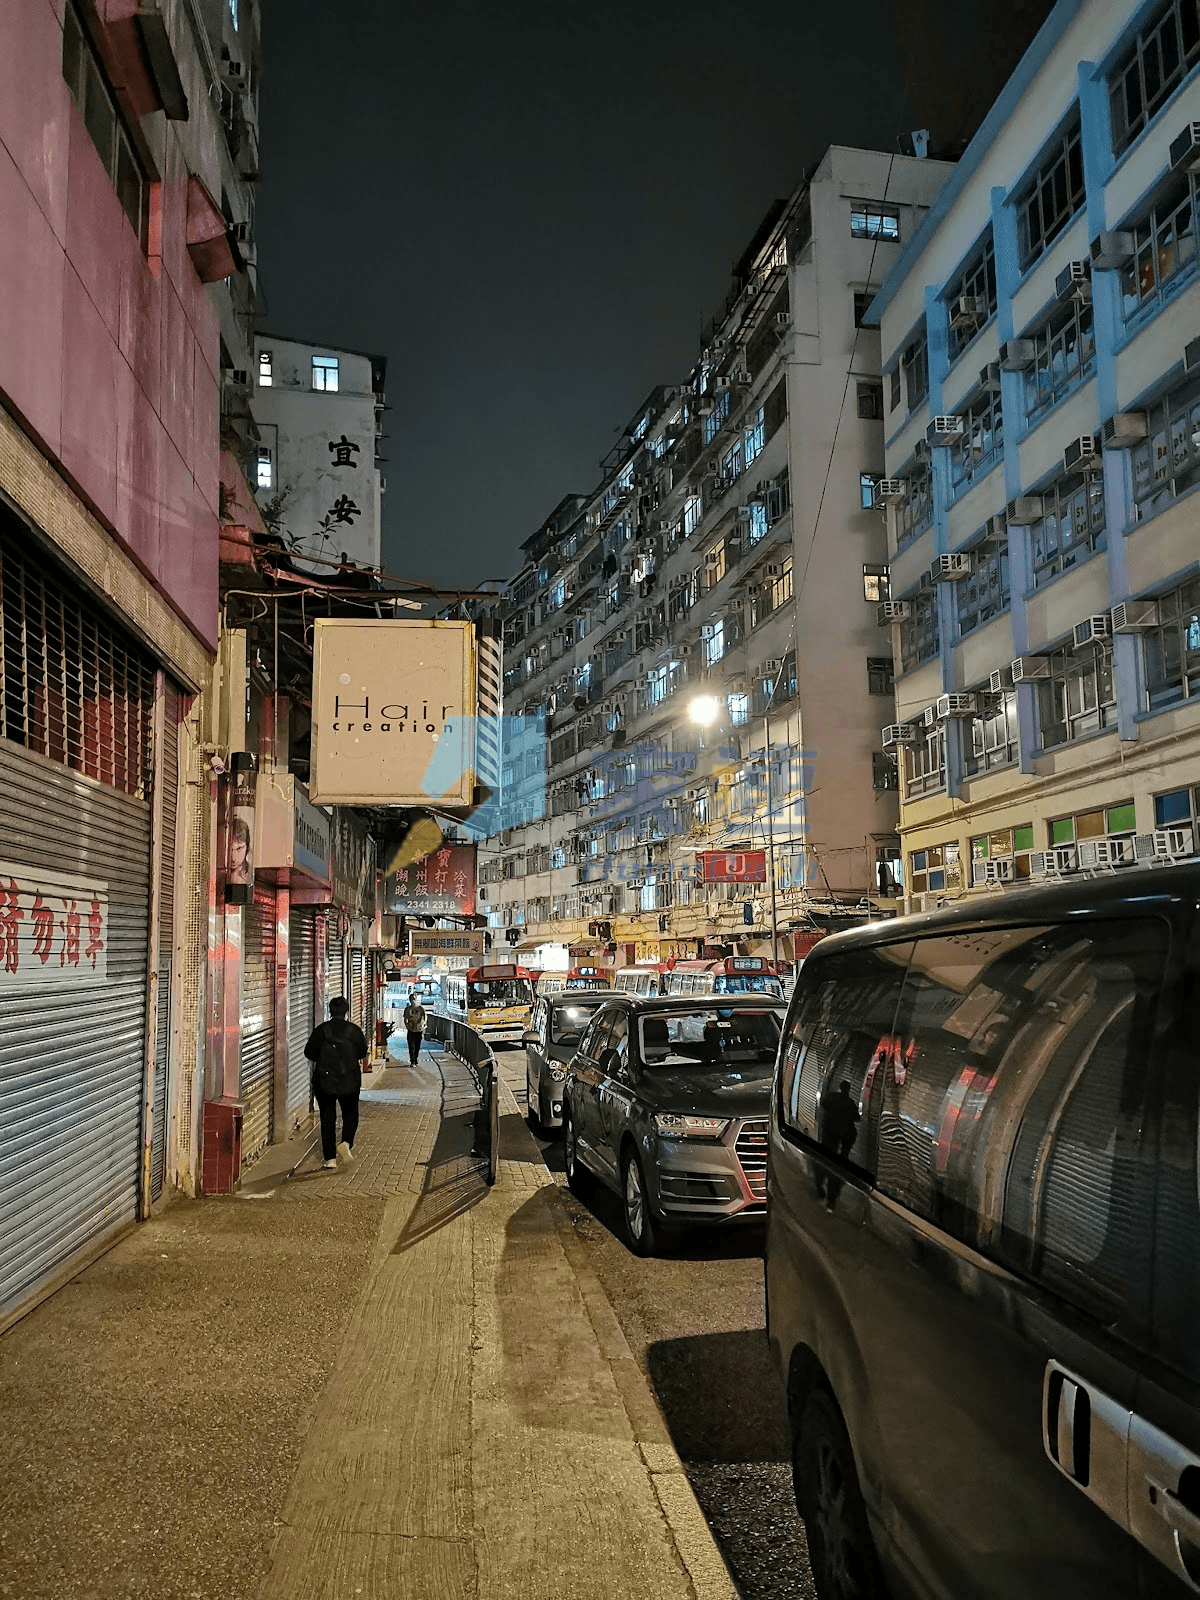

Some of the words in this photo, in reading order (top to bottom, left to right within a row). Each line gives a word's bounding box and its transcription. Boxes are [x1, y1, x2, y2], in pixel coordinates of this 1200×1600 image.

[335, 695, 454, 720] Hair
[332, 720, 453, 733] creation
[411, 847, 452, 868] 新寶
[395, 868, 467, 883] 潮州打冷
[394, 883, 467, 898] 晚飯小菜
[407, 900, 430, 909] 2341
[432, 900, 456, 909] 2318
